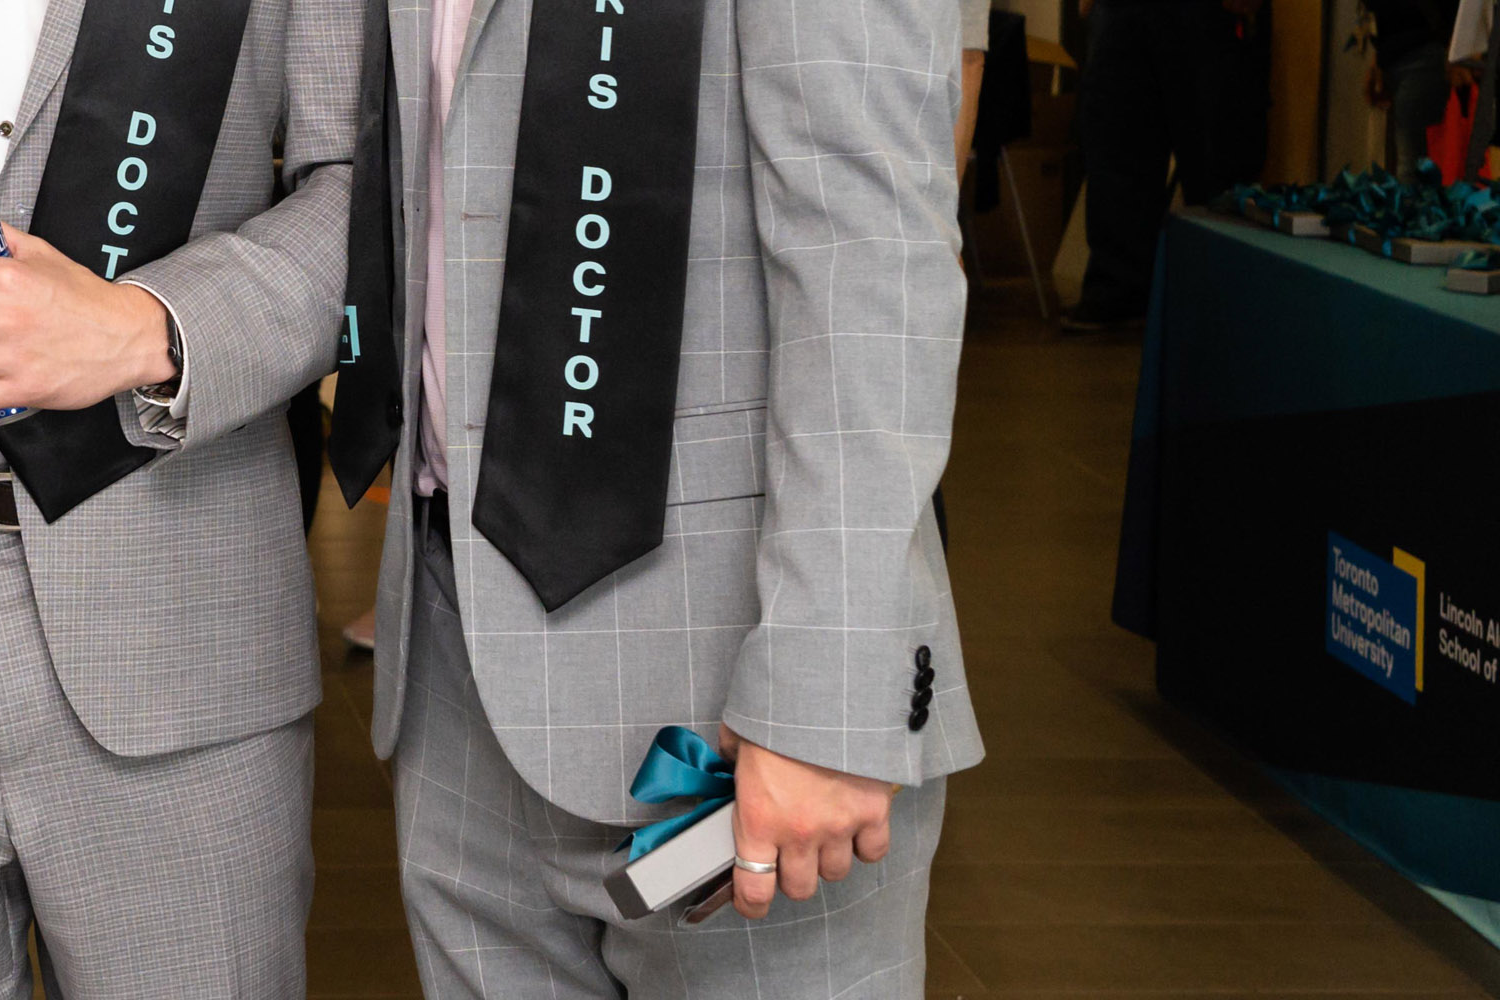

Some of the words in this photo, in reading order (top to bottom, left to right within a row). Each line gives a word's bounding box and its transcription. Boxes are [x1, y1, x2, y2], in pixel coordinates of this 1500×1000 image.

[100, 110, 157, 281] DOCT
[562, 166, 612, 438] DOCTOR
[1332, 545, 1379, 598] Toronto
[1331, 579, 1411, 650] Metropolitan
[1331, 612, 1394, 679] University
[1439, 591, 1484, 640] Lincoln
[1438, 628, 1481, 675] School
[1483, 657, 1498, 684] of
